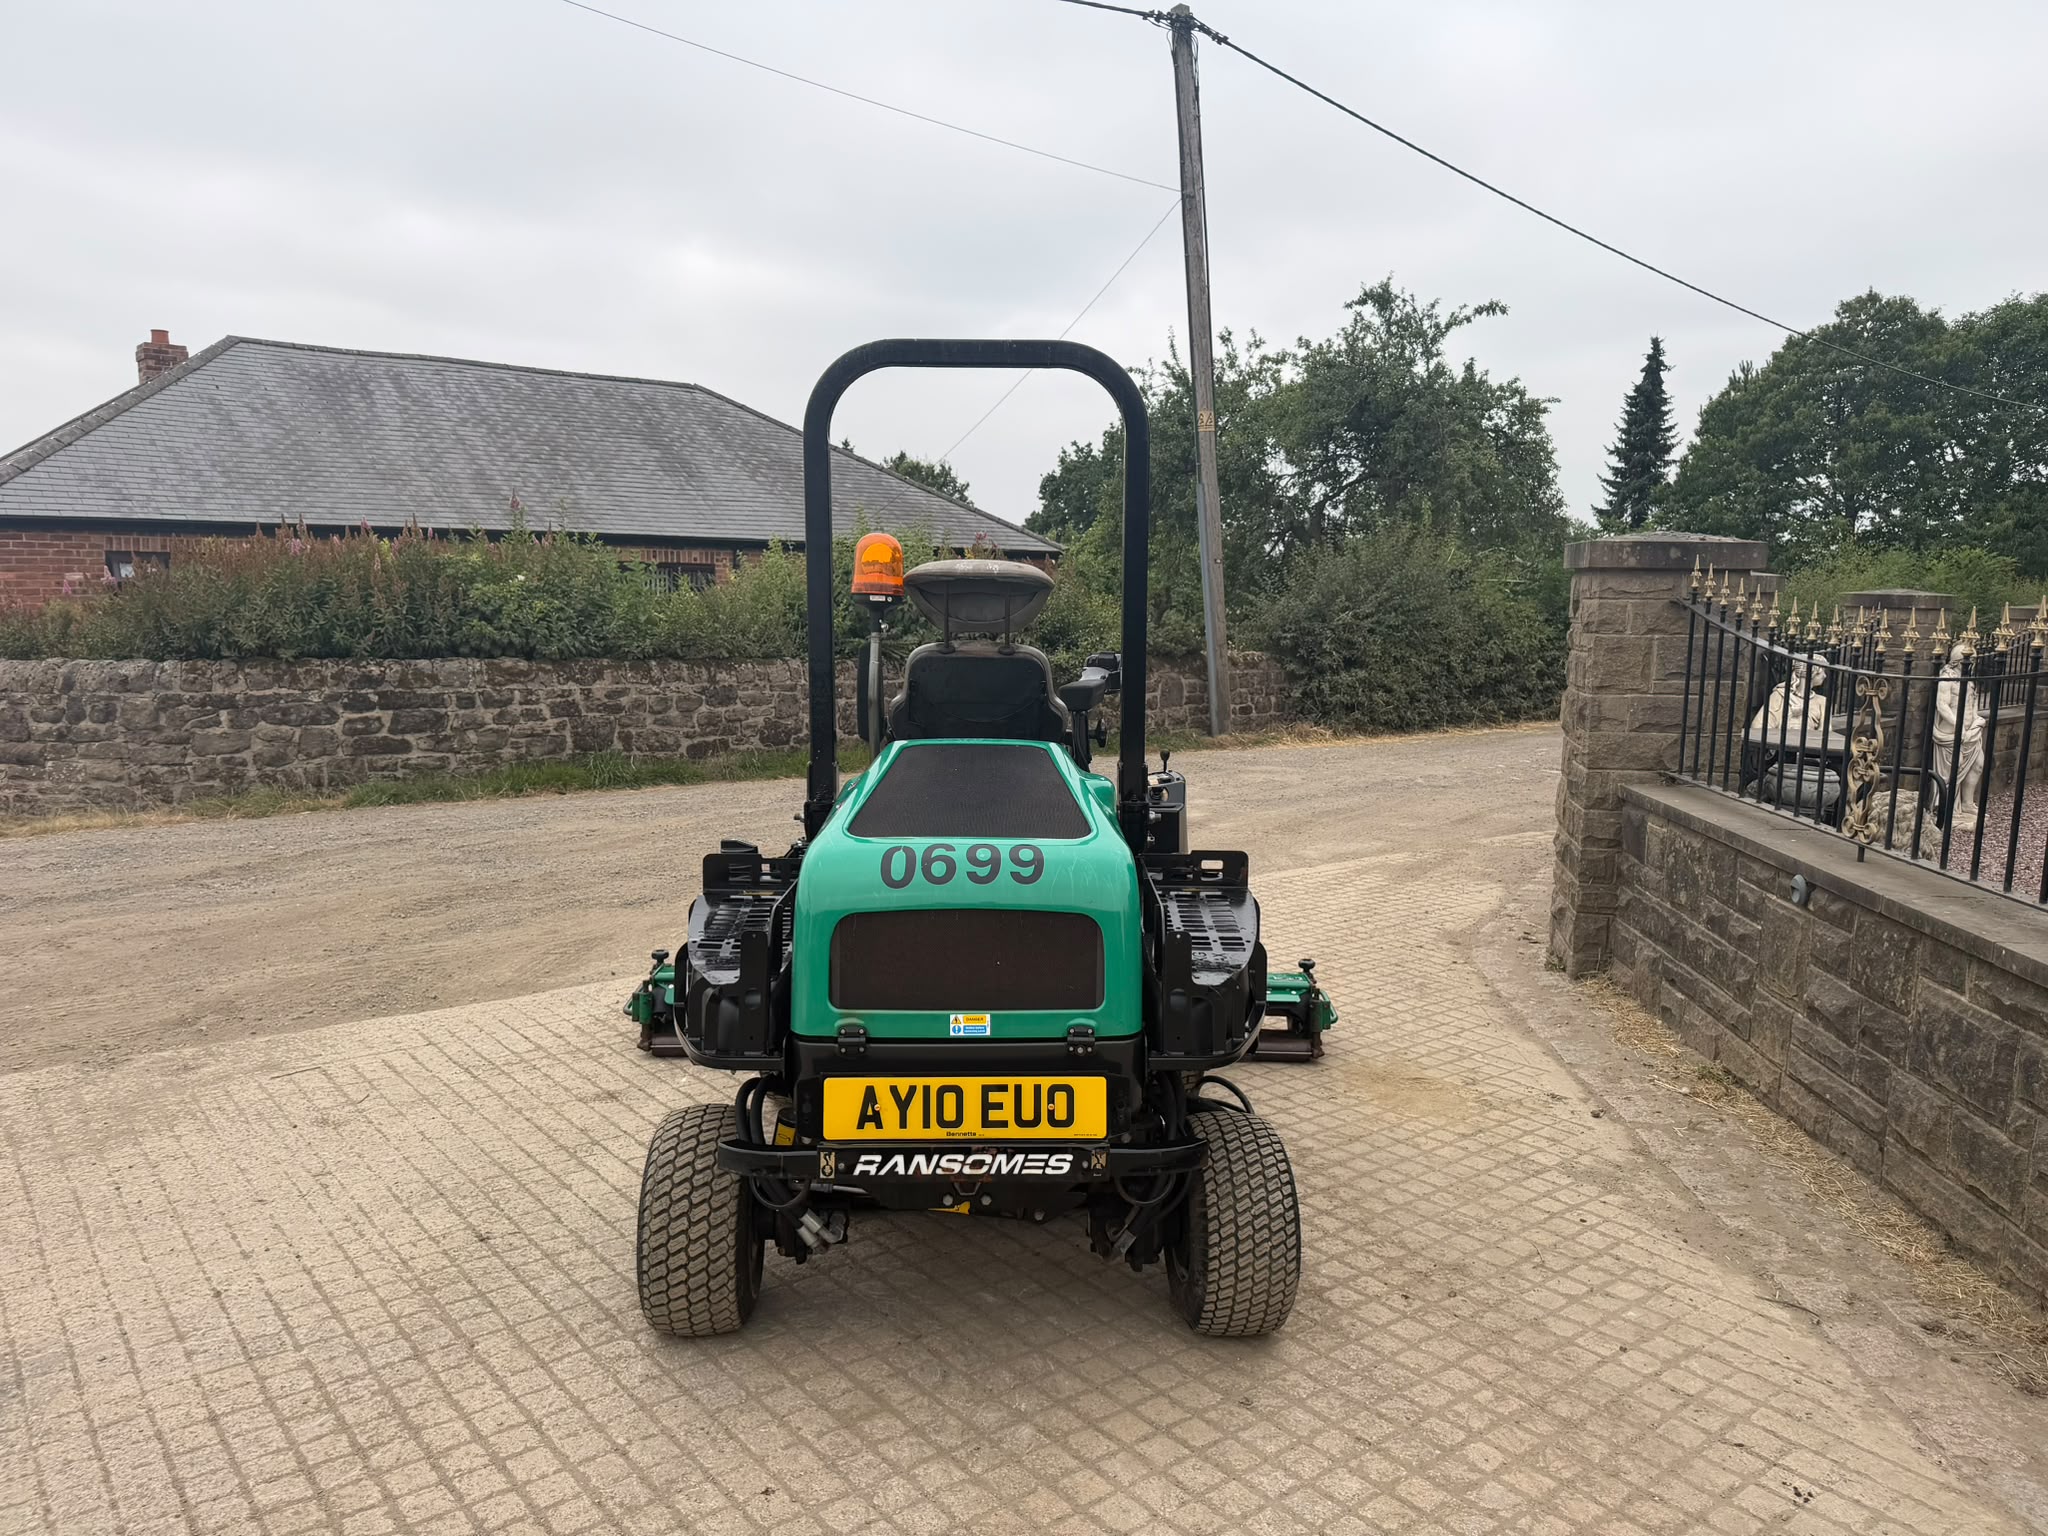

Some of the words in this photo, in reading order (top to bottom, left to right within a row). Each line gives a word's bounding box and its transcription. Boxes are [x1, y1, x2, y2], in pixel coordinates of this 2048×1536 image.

[880, 843, 1045, 889] 0699
[856, 1084, 964, 1130] AY10
[852, 1153, 1074, 1176] RANSOMES
